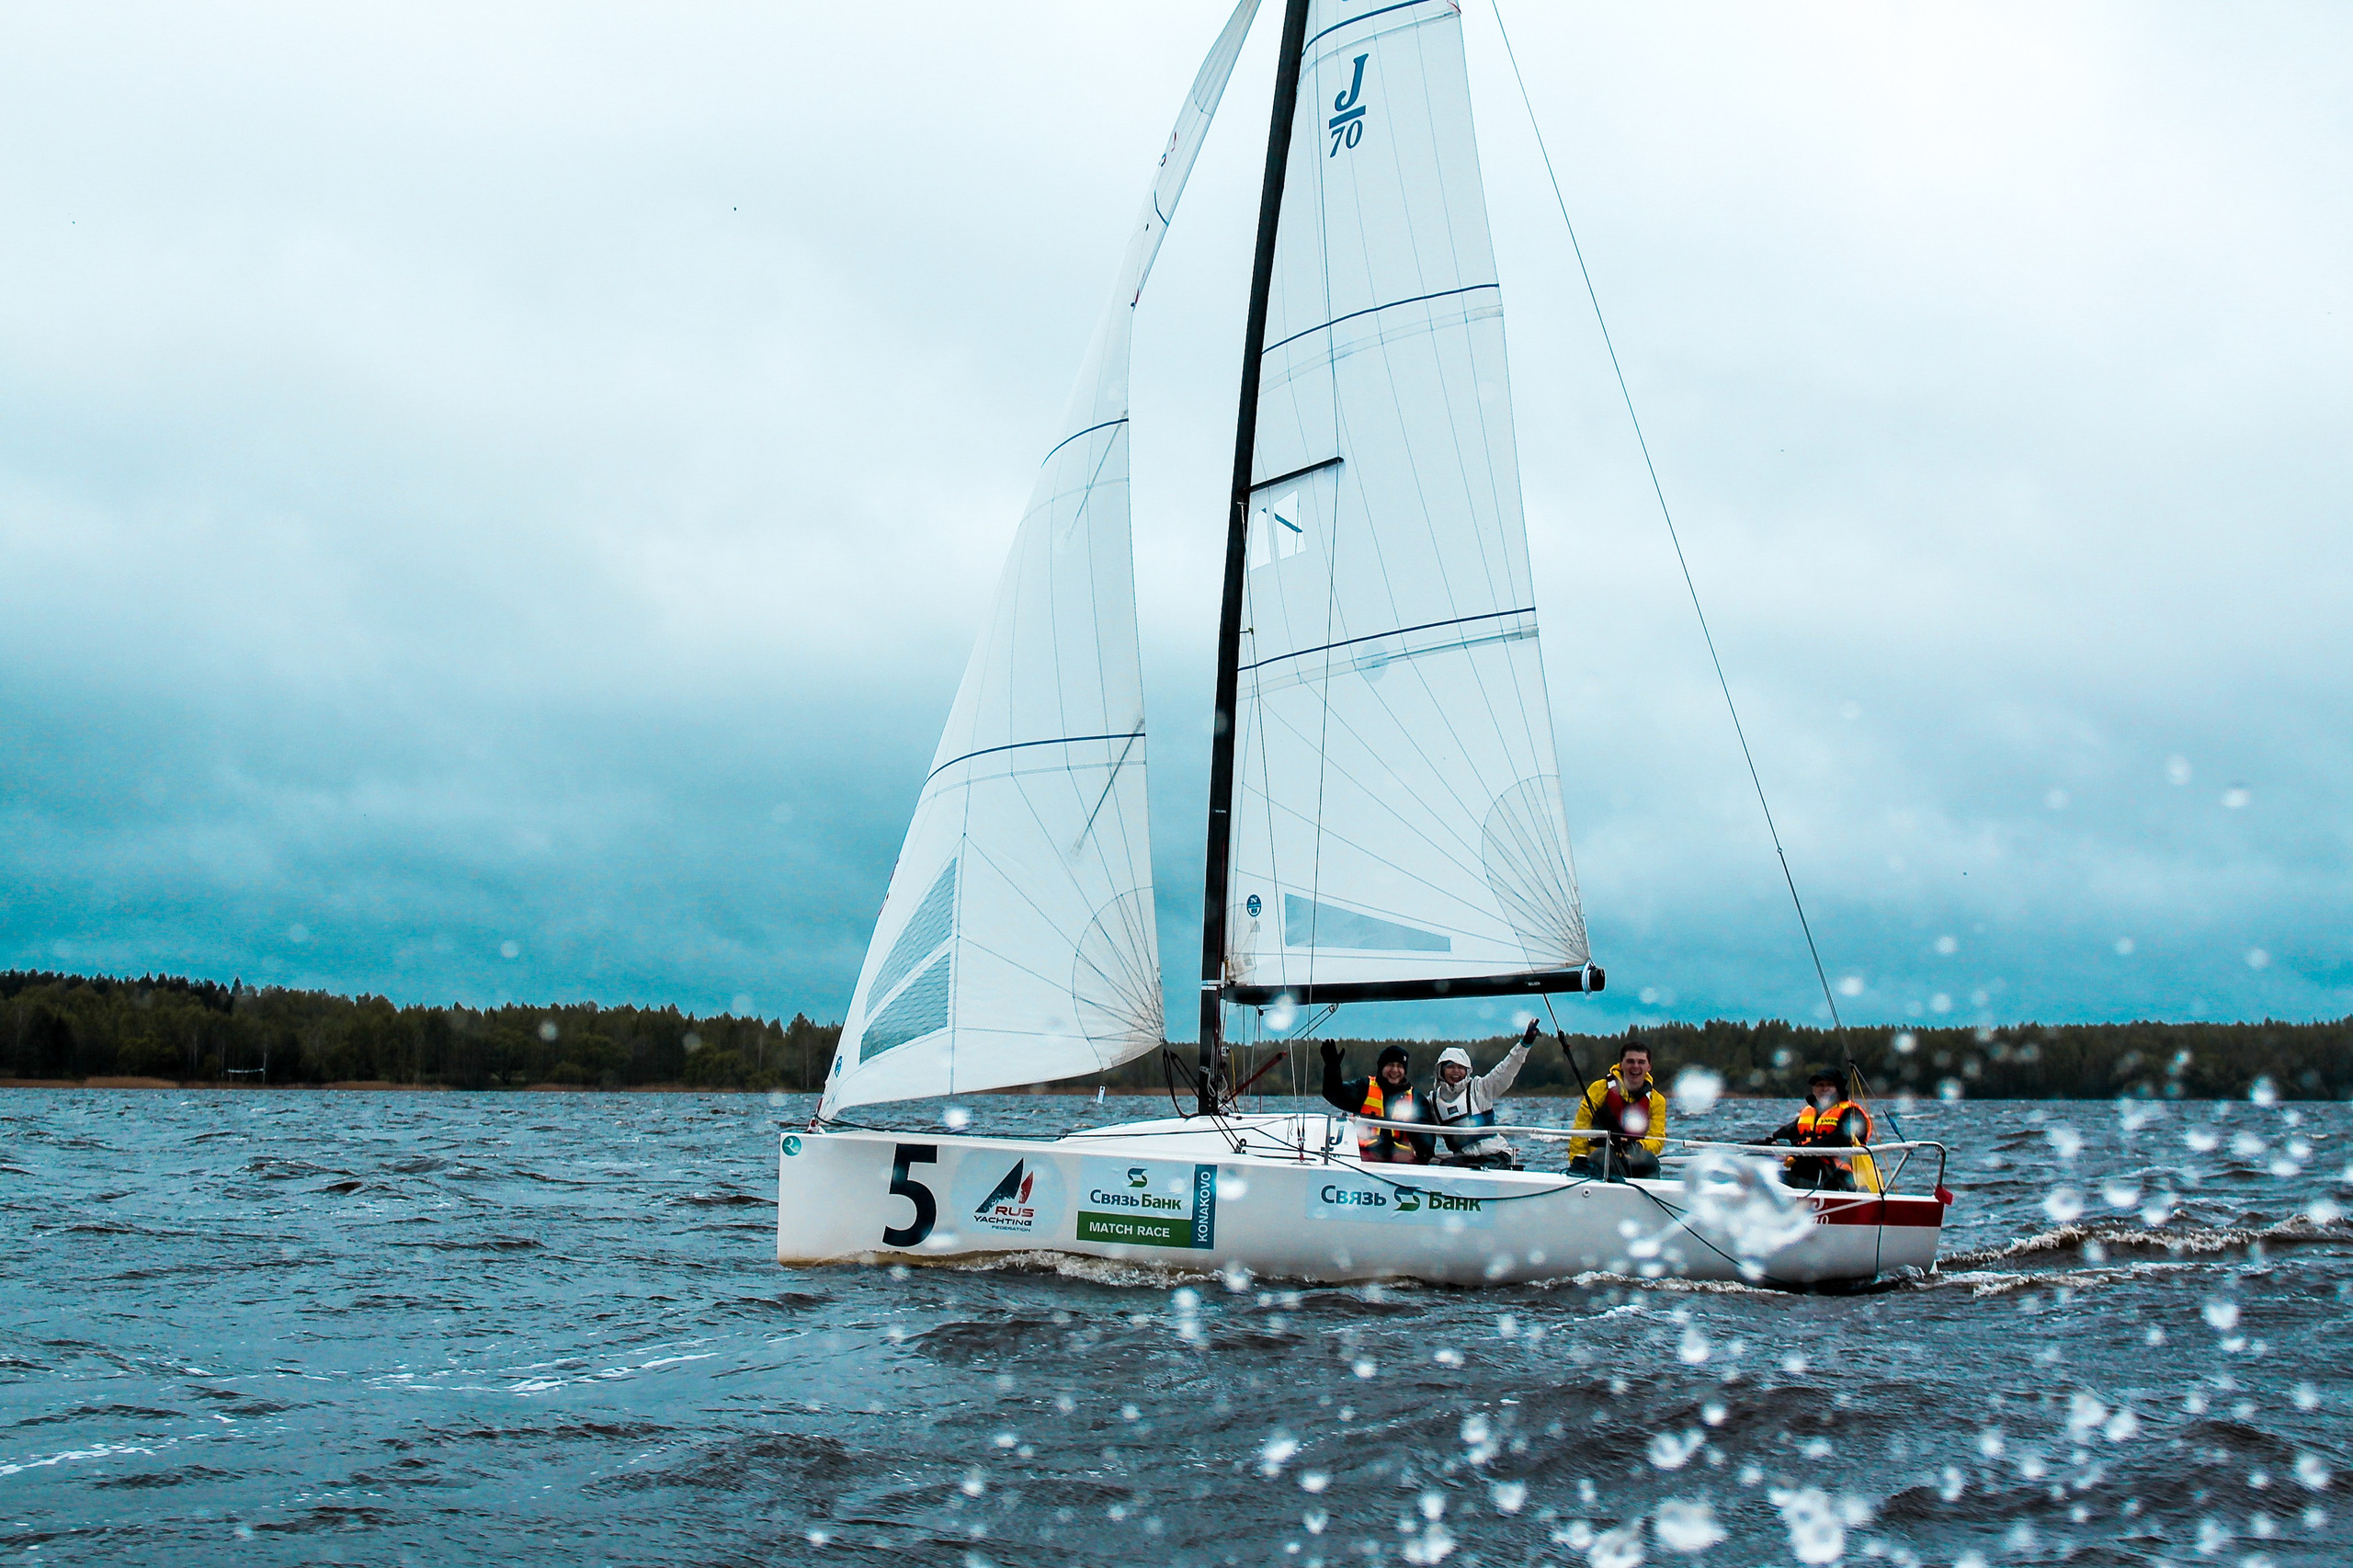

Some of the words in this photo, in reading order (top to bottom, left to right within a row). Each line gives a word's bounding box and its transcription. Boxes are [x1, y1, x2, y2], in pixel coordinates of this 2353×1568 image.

[1335, 53, 1370, 111] J
[1330, 119, 1363, 158] 70
[881, 1142, 938, 1248] 5
[1198, 1171, 1211, 1243] KONAKOVO
[1321, 1185, 1387, 1207] Связь
[1428, 1190, 1482, 1212] Банк
[973, 1215, 1033, 1227] YACHTING
[995, 1205, 1035, 1219] RUS
[1089, 1221, 1133, 1235] MATCH
[1137, 1225, 1171, 1238] RACE
